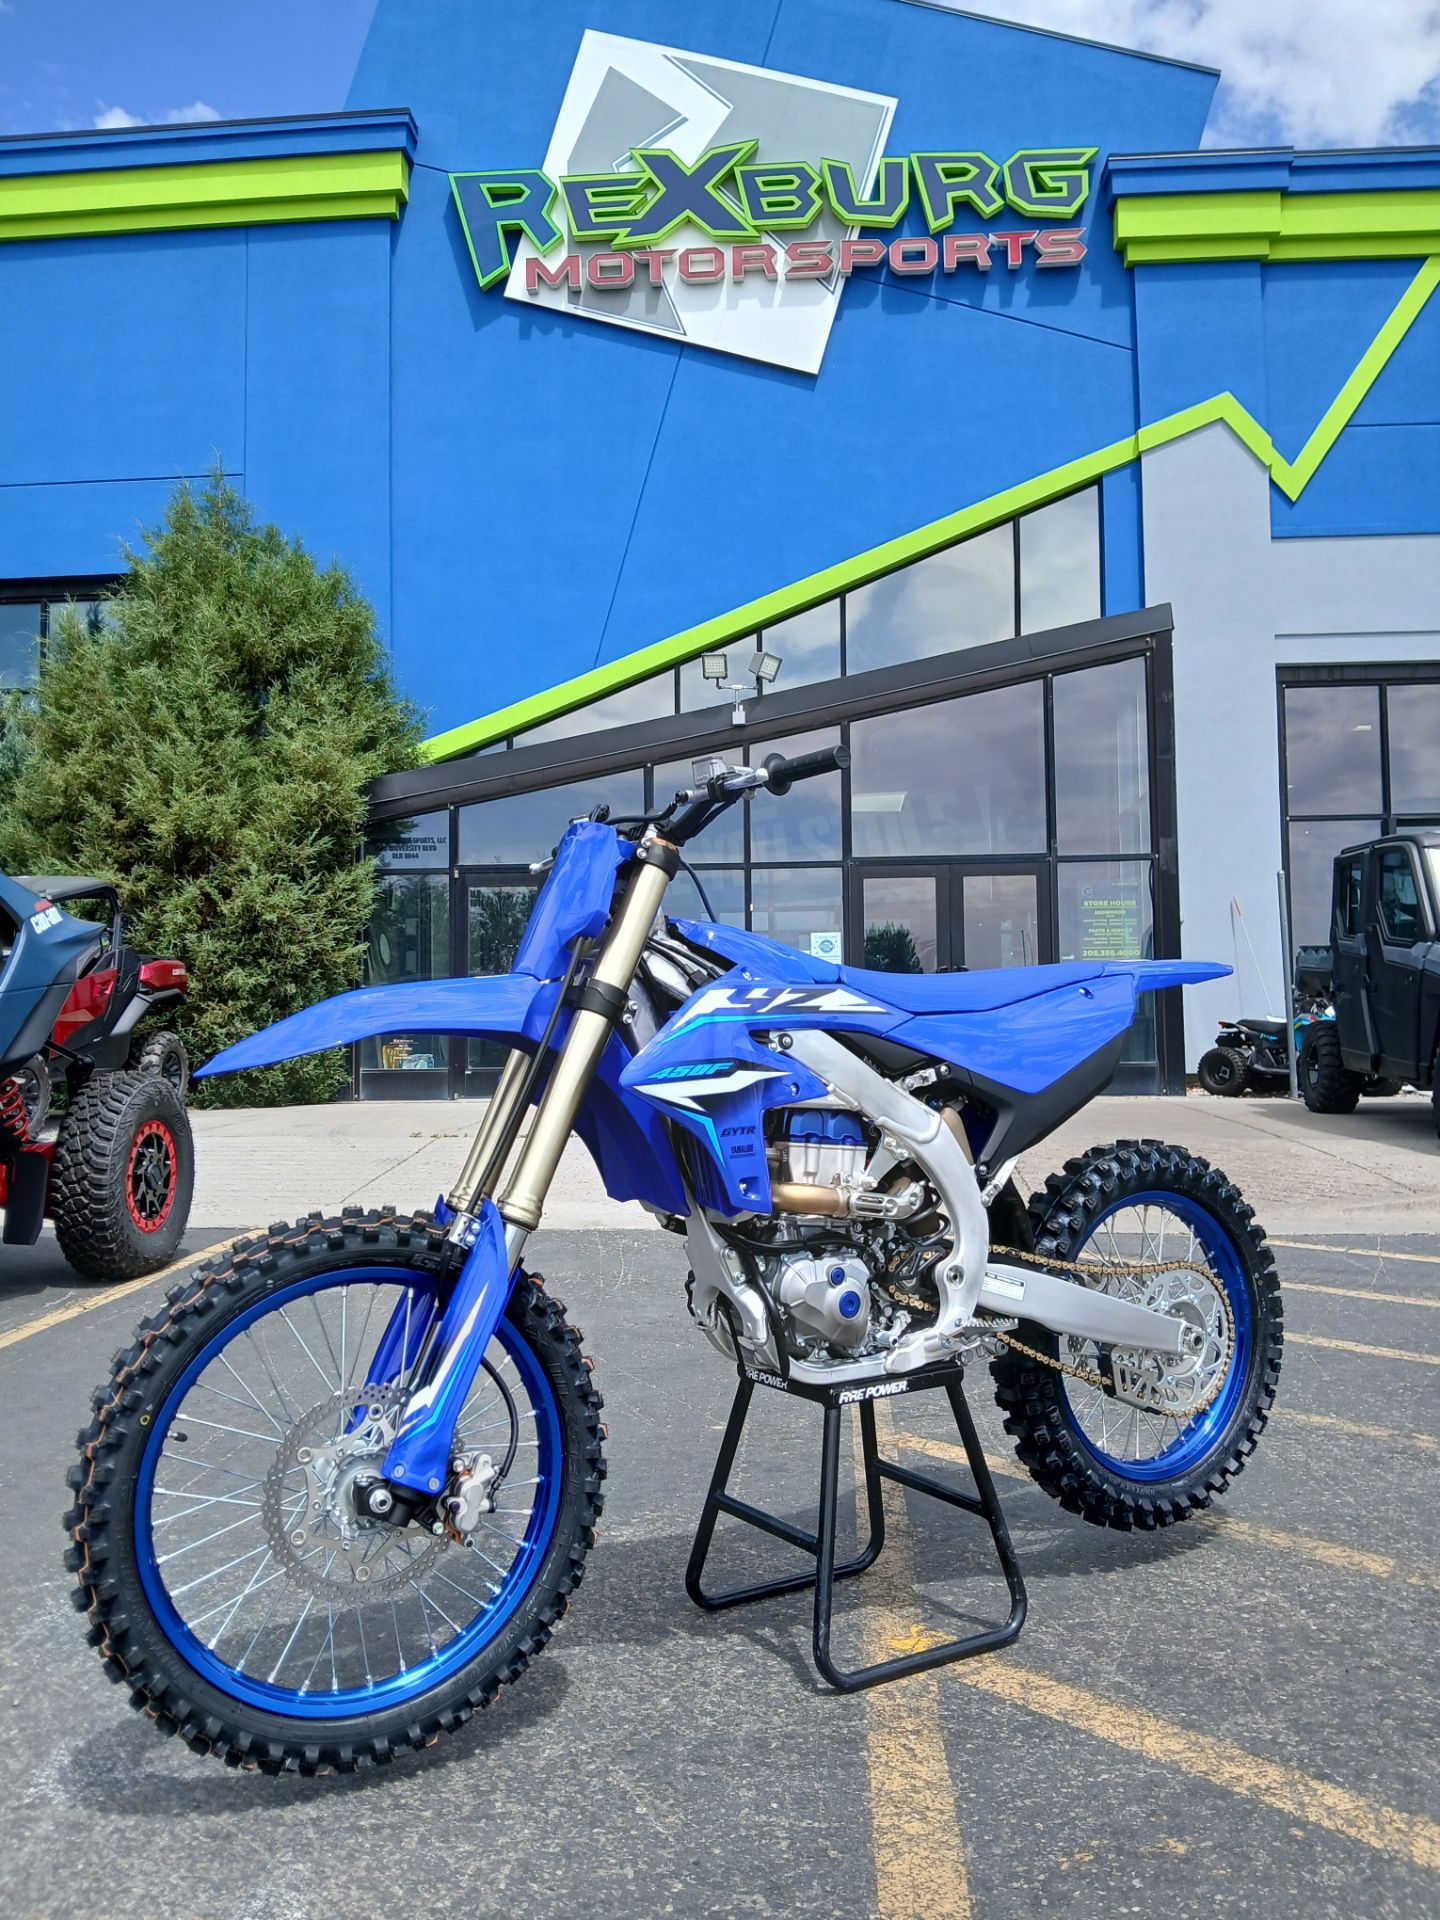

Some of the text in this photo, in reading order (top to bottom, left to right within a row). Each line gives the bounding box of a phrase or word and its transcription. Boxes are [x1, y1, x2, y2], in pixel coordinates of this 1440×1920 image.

[448, 138, 1100, 291] REXBURG
[524, 227, 1088, 295] MOTORSPORTS
[647, 1062, 734, 1079] 450F
[720, 1125, 756, 1137] GYTR
[758, 1372, 788, 1390] POWER
[865, 1380, 907, 1399] POWER
